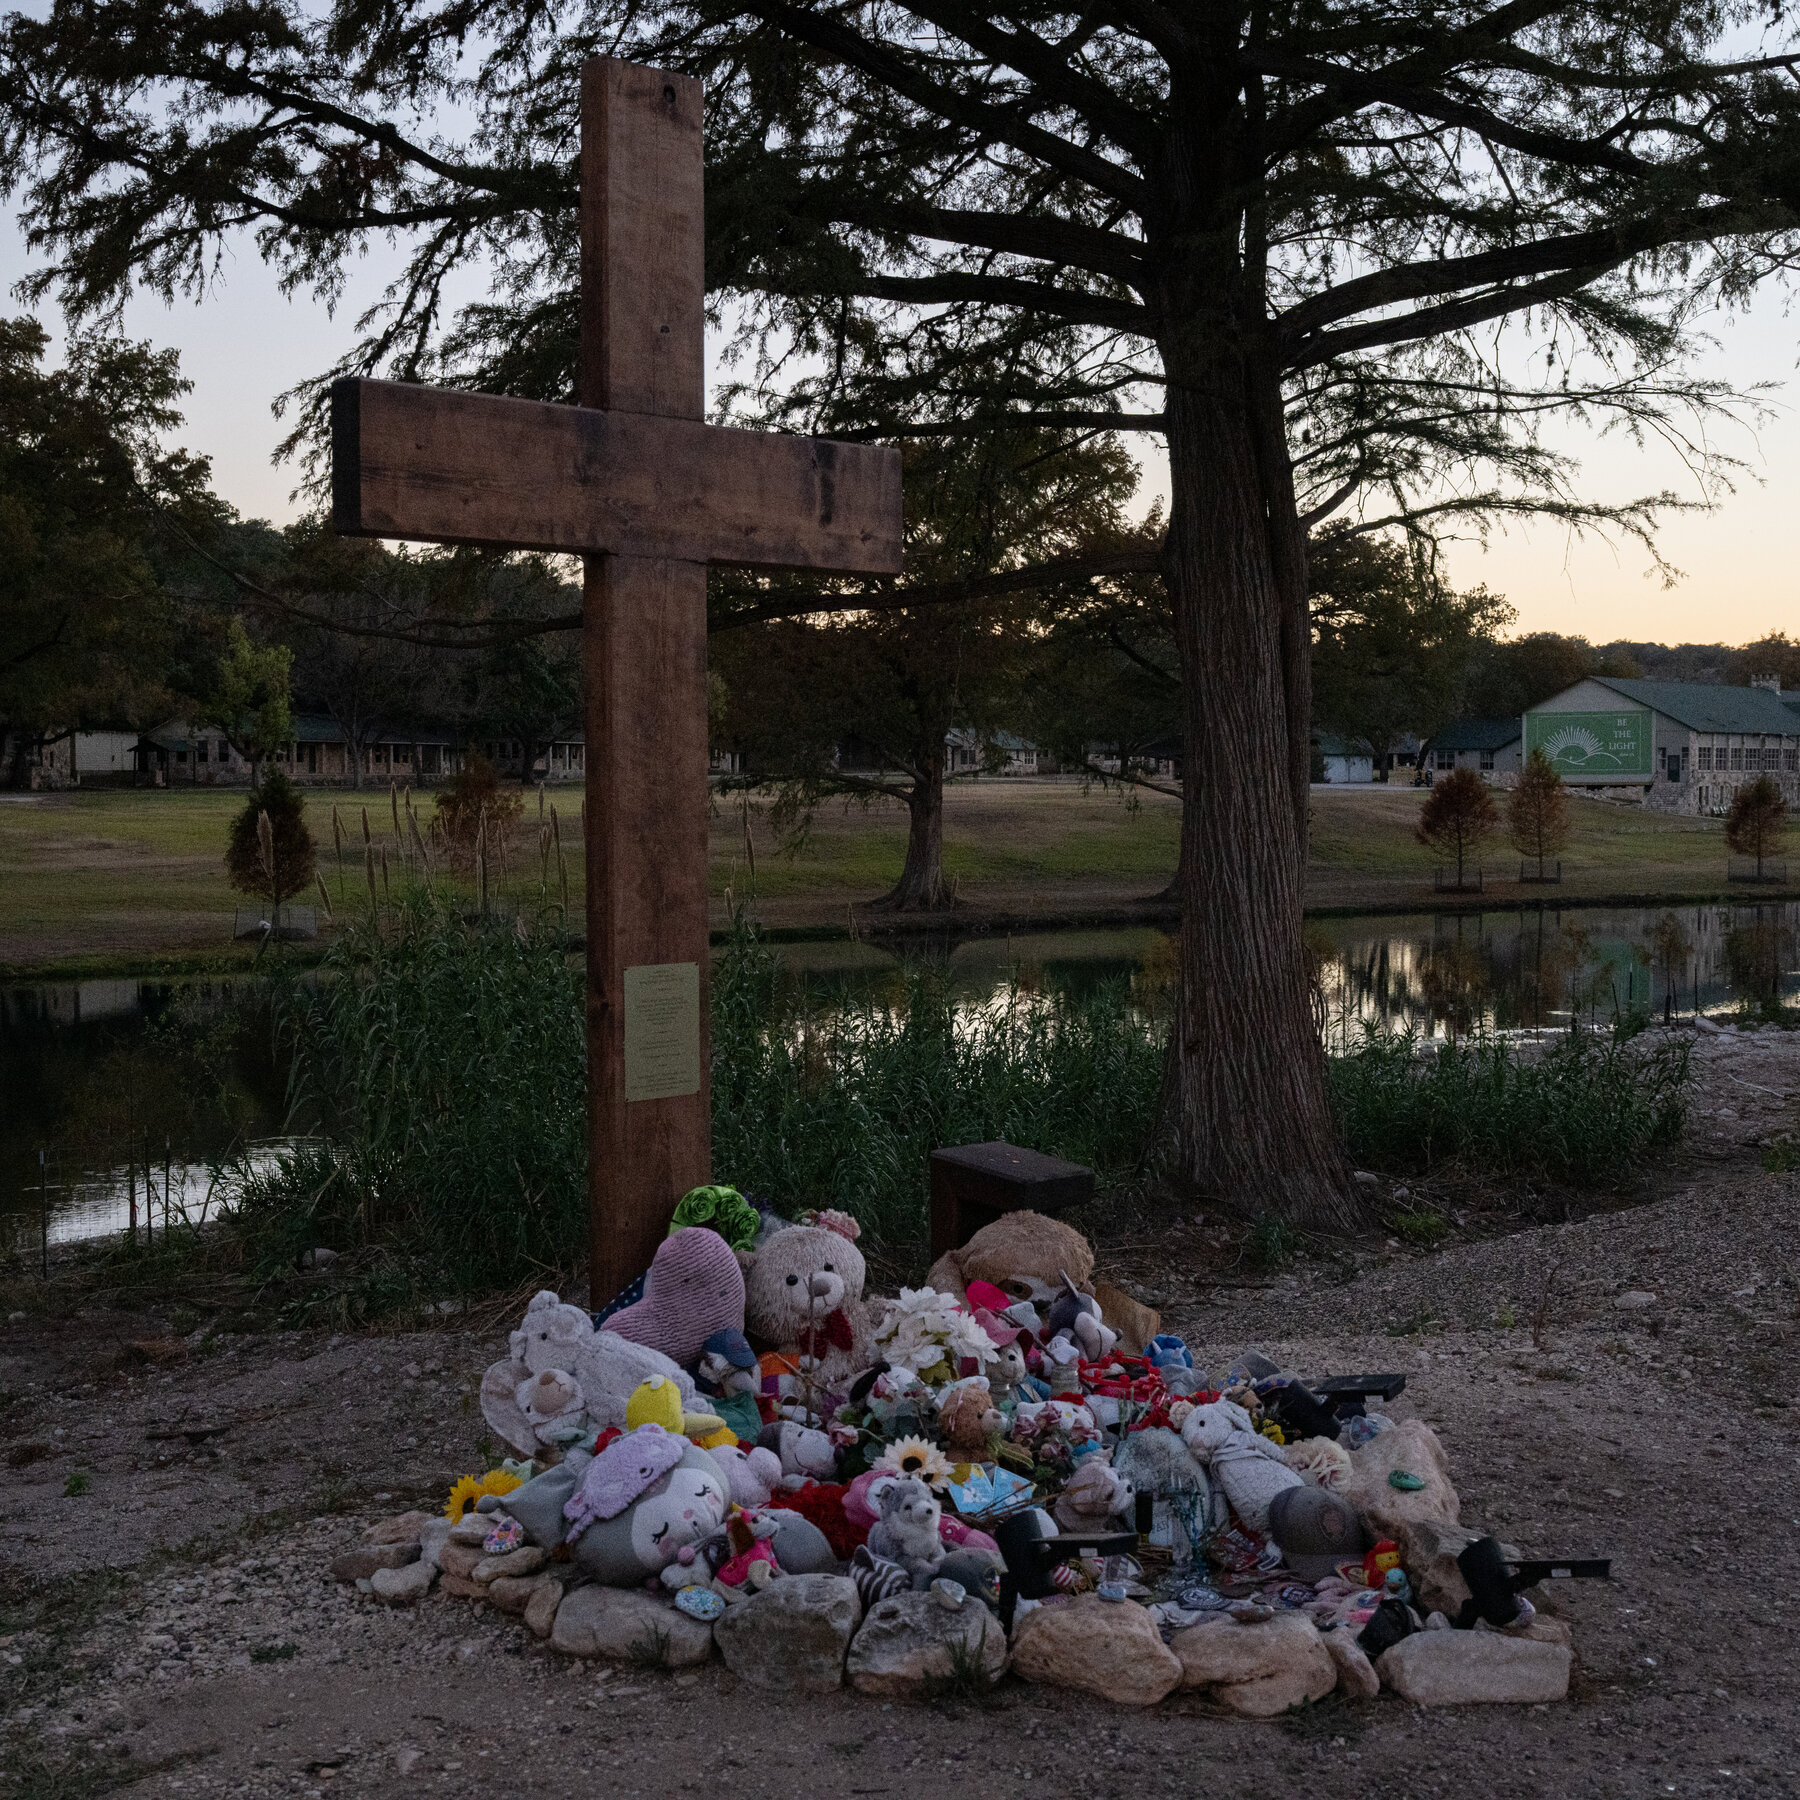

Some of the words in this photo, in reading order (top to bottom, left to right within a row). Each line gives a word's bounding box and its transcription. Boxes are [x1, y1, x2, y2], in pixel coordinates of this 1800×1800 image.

[1617, 718, 1627, 727] BE
[1613, 730, 1632, 738] THE
[1608, 741, 1636, 750] LIGHT
